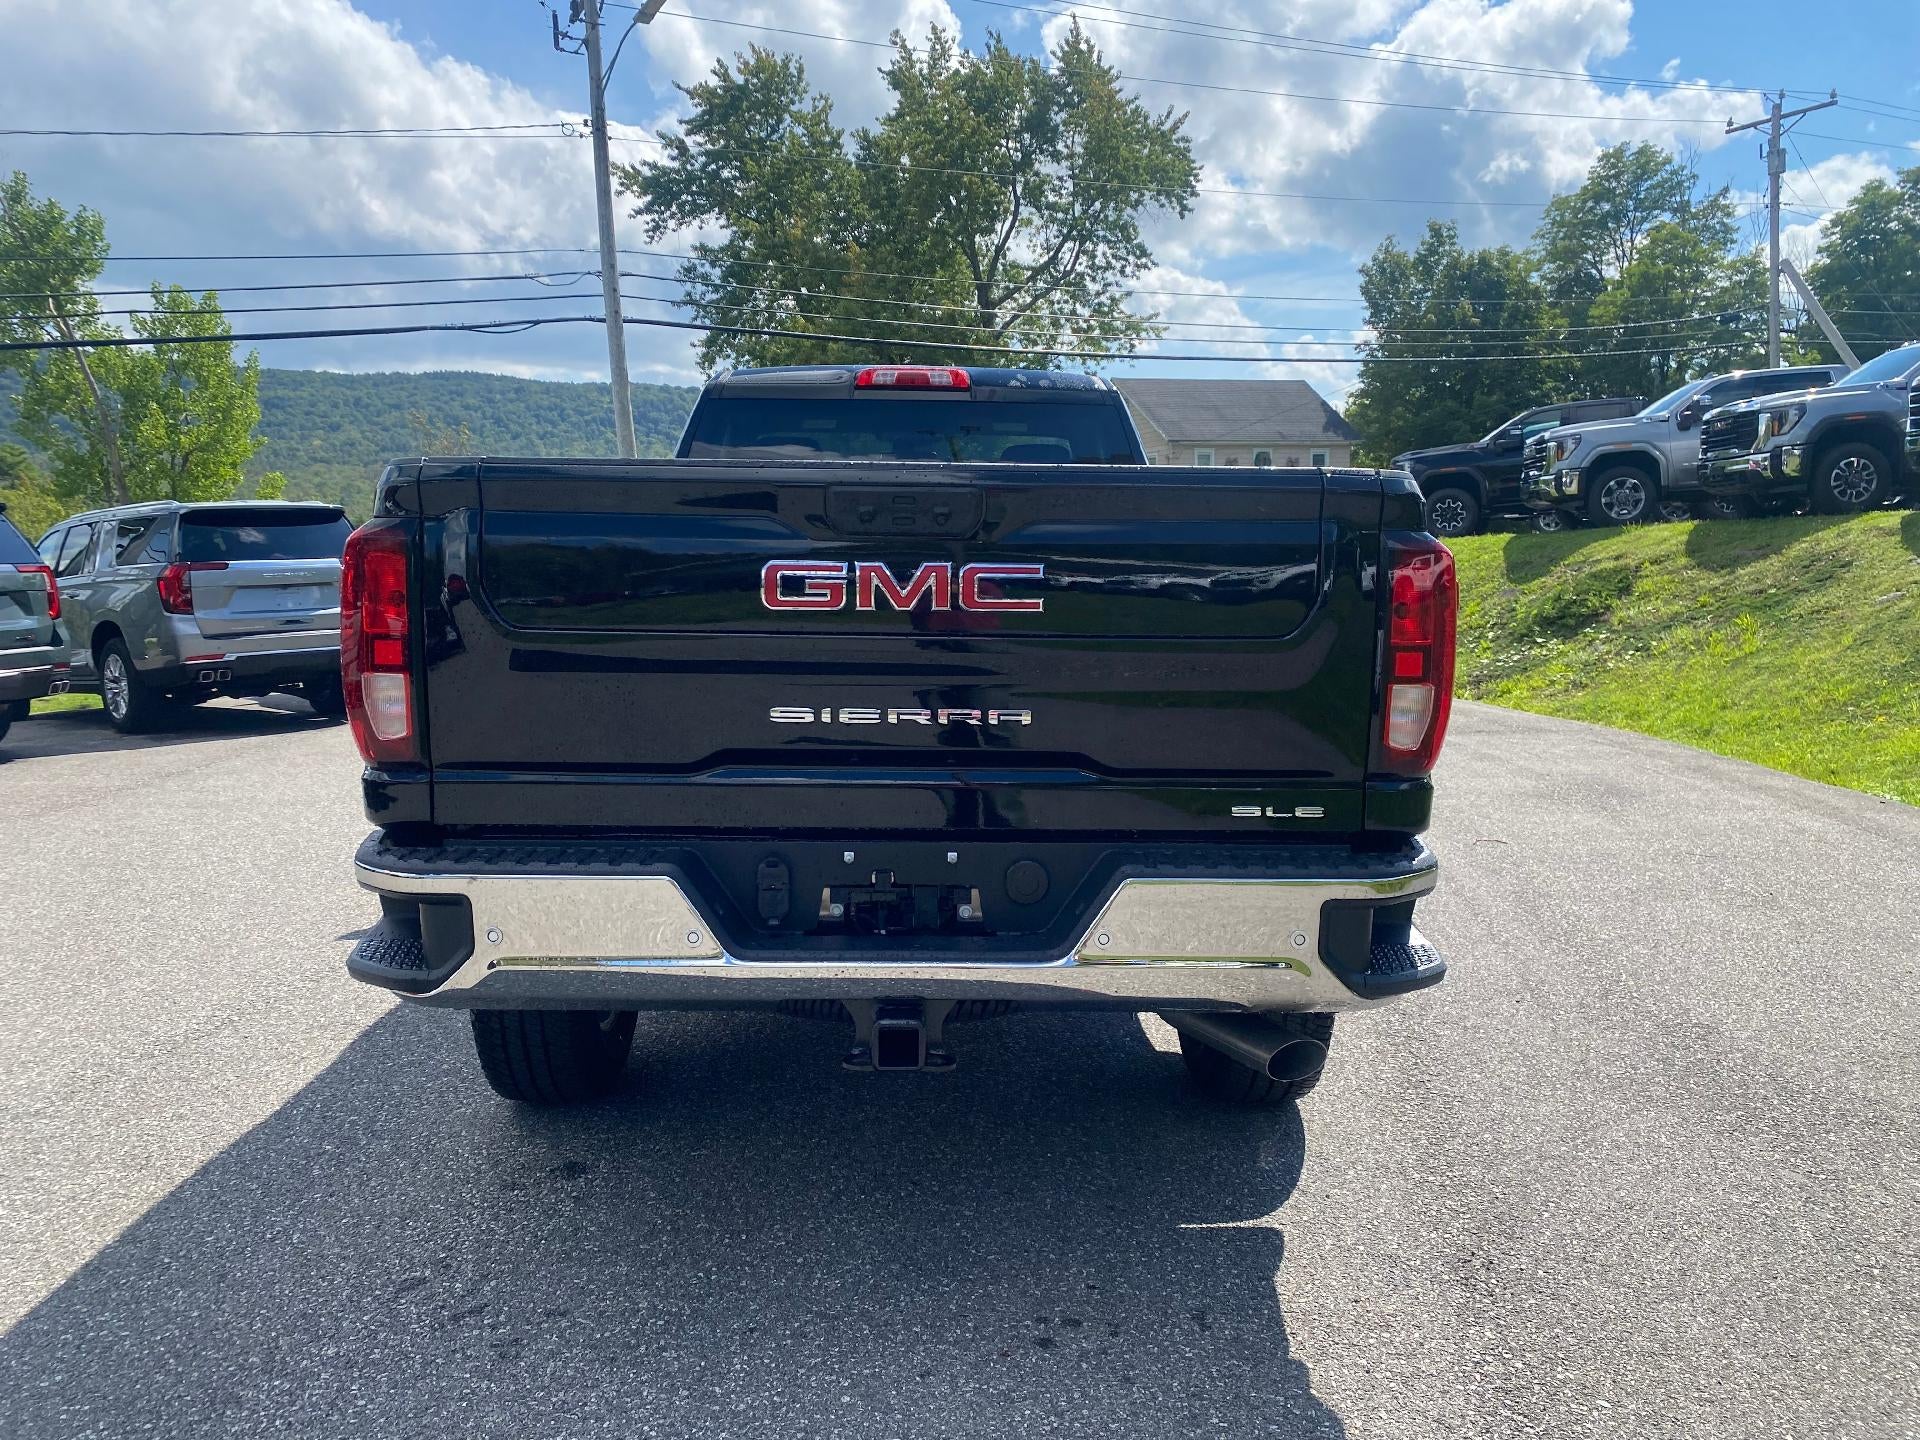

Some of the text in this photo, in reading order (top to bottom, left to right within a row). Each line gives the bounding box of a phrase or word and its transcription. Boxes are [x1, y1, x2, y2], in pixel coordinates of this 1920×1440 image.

[760, 559, 1044, 612] GMC
[769, 707, 1032, 725] SIERRA
[1231, 805, 1325, 818] SLE
